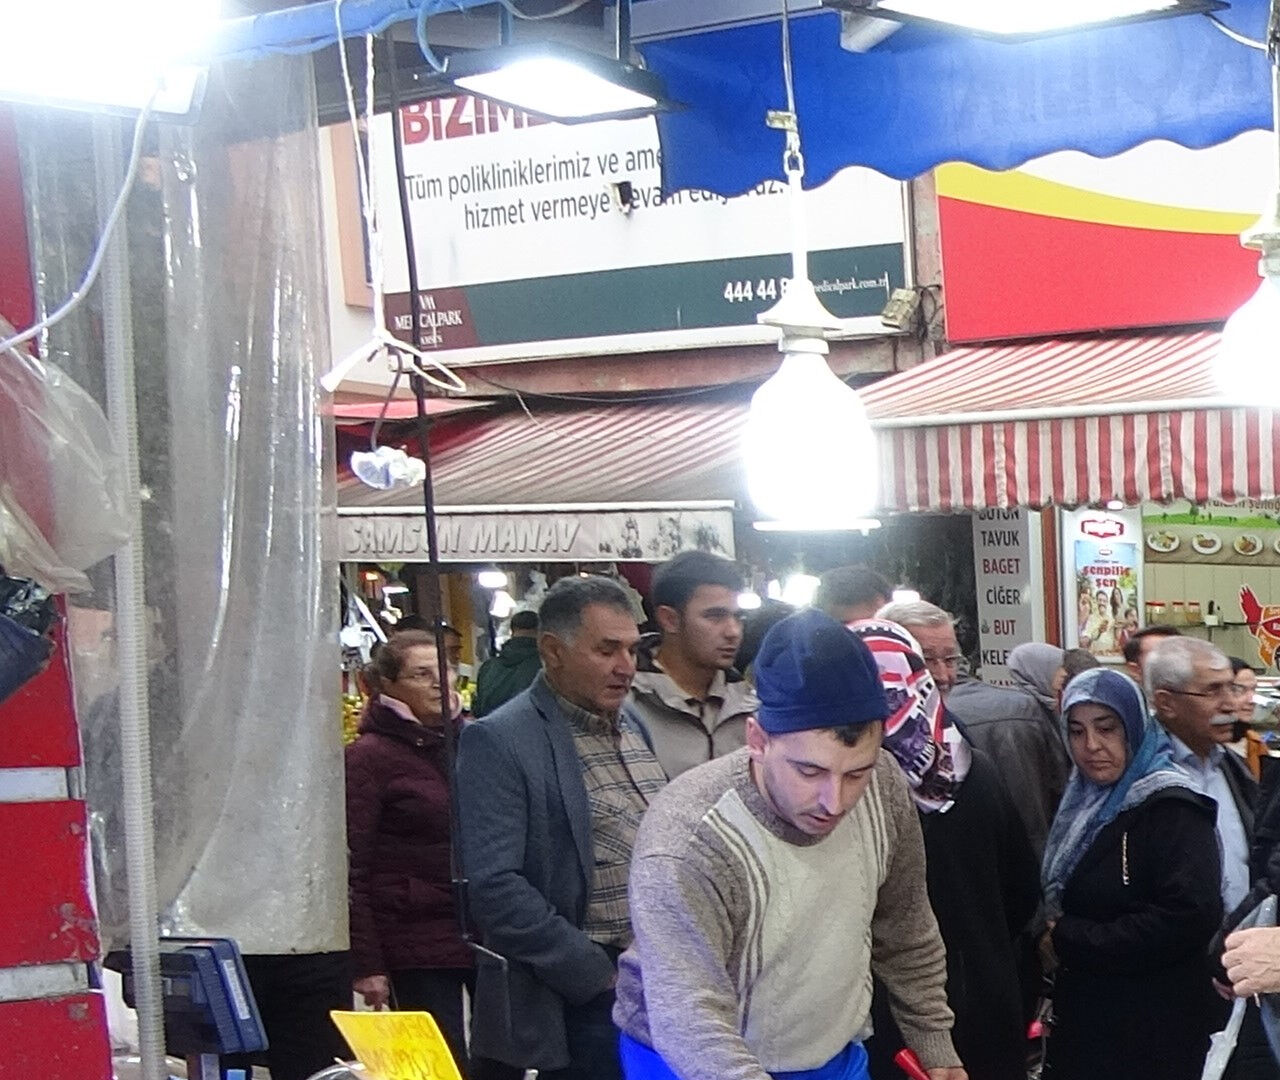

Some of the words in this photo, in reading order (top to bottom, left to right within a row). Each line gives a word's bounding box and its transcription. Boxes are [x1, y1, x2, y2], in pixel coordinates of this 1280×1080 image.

[405, 174, 443, 202] Tüm
[449, 151, 592, 203] polikliniklerimiz
[597, 153, 619, 176] ve
[464, 197, 526, 231] hizmet
[532, 189, 610, 221] vermeye
[724, 280, 753, 303] 444
[756, 278, 777, 300] 44
[470, 518, 582, 554] MANAV
[981, 530, 1020, 547] TAVUK
[983, 558, 1021, 575] BAGET
[993, 619, 1017, 636] BUT
